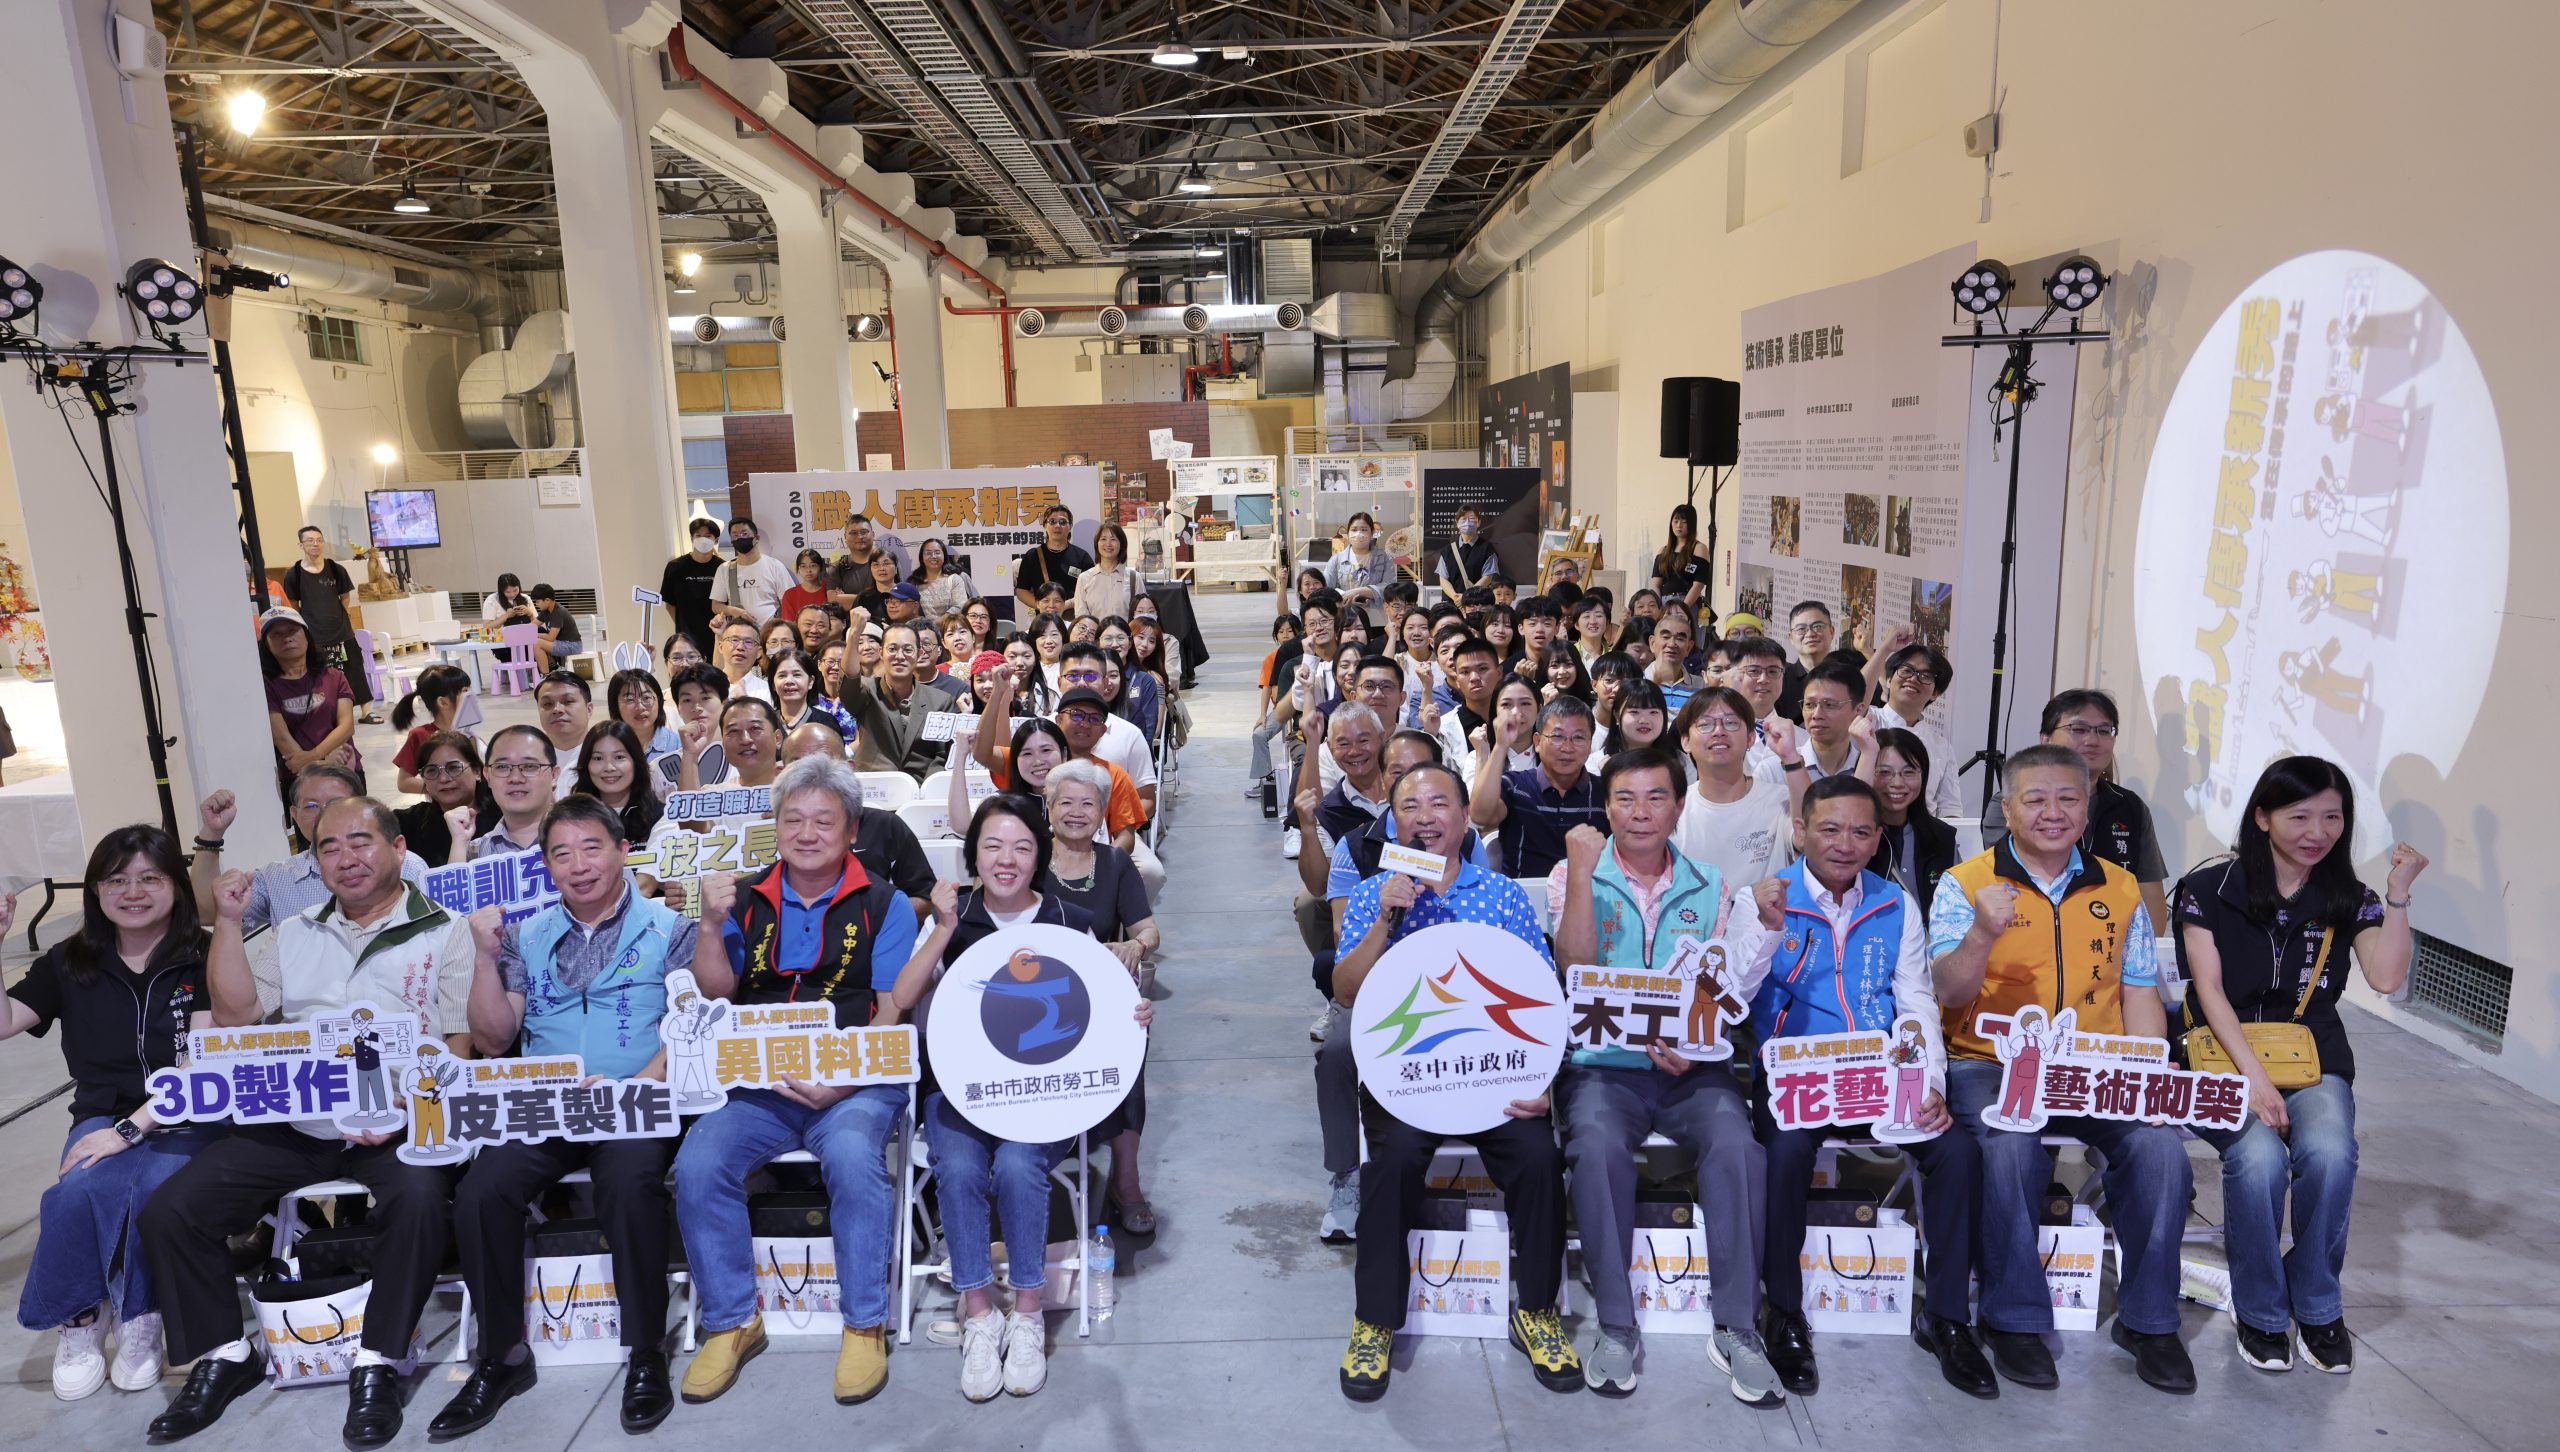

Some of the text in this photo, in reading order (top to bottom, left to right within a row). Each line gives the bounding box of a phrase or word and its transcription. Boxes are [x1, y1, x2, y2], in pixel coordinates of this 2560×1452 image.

[1746, 325, 1844, 372] 技術傳承 績優單位
[789, 491, 805, 549] 2026
[809, 486, 1060, 531] 職人傳承新秀
[667, 788, 773, 820] 打造職場
[625, 823, 777, 879] 一技之長
[2106, 922, 2116, 963] 理事長
[1862, 945, 1873, 976] 理事長
[1581, 972, 1683, 993] 職人傳承新秀
[739, 1007, 829, 1025] 職人傳承新秀
[1571, 997, 1680, 1048] 木工
[194, 1037, 202, 1060] 2026
[203, 1030, 311, 1053] 職人傳承新秀
[716, 1030, 912, 1085] 異國料理
[1778, 1037, 1883, 1060] 職人傳承新秀
[2074, 1038, 2164, 1057] 職人傳承新秀
[465, 1066, 473, 1089] 2026
[474, 1061, 578, 1081] 職人傳承新秀
[1400, 1049, 1527, 1083] 臺中市政府
[152, 1060, 350, 1118] 3D製作
[965, 1067, 1120, 1102] 臺中市政府勞工局
[966, 1102, 984, 1110] Labor
[986, 1100, 1007, 1108] Affairs
[1008, 1098, 1031, 1106] Bureau
[1040, 1094, 1068, 1102] Taichung
[1069, 1091, 1082, 1100] City
[1083, 1088, 1121, 1097] Government
[1387, 1072, 1548, 1098] TAICHUNG CITY GOVERNMENT
[1775, 1066, 1889, 1124] 花藝
[2042, 1064, 2244, 1124] 藝術砌築
[448, 1085, 672, 1141] 皮革製作
[1631, 1255, 1709, 1272] 人傳承新
